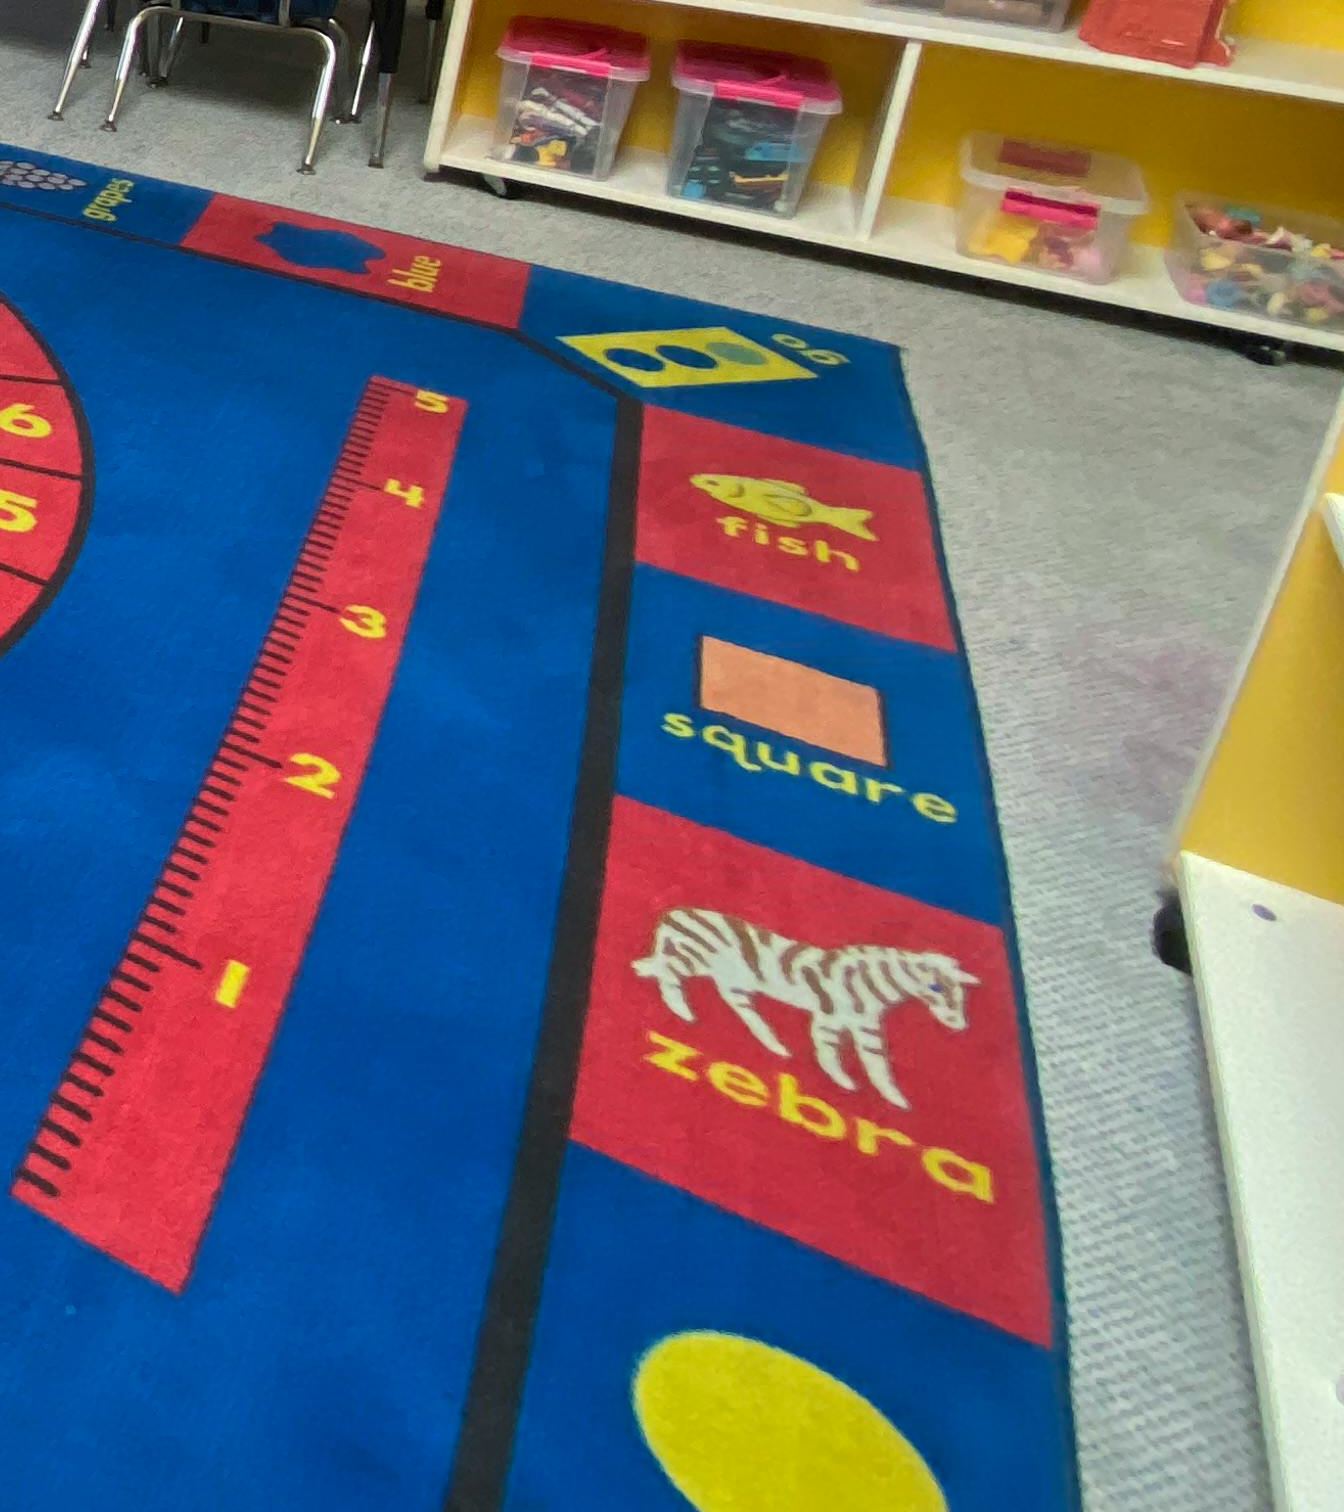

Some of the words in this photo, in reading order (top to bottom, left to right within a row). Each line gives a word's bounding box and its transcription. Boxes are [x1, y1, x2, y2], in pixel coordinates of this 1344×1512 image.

[82, 177, 135, 223] grapes
[388, 256, 440, 292] blue
[415, 390, 448, 412] 5
[385, 479, 423, 507] 4
[716, 515, 861, 573] fish
[340, 605, 385, 638] 3
[285, 753, 340, 798] 2
[662, 711, 958, 824] square
[216, 960, 248, 1007] 1
[644, 1030, 995, 1204] zebra
